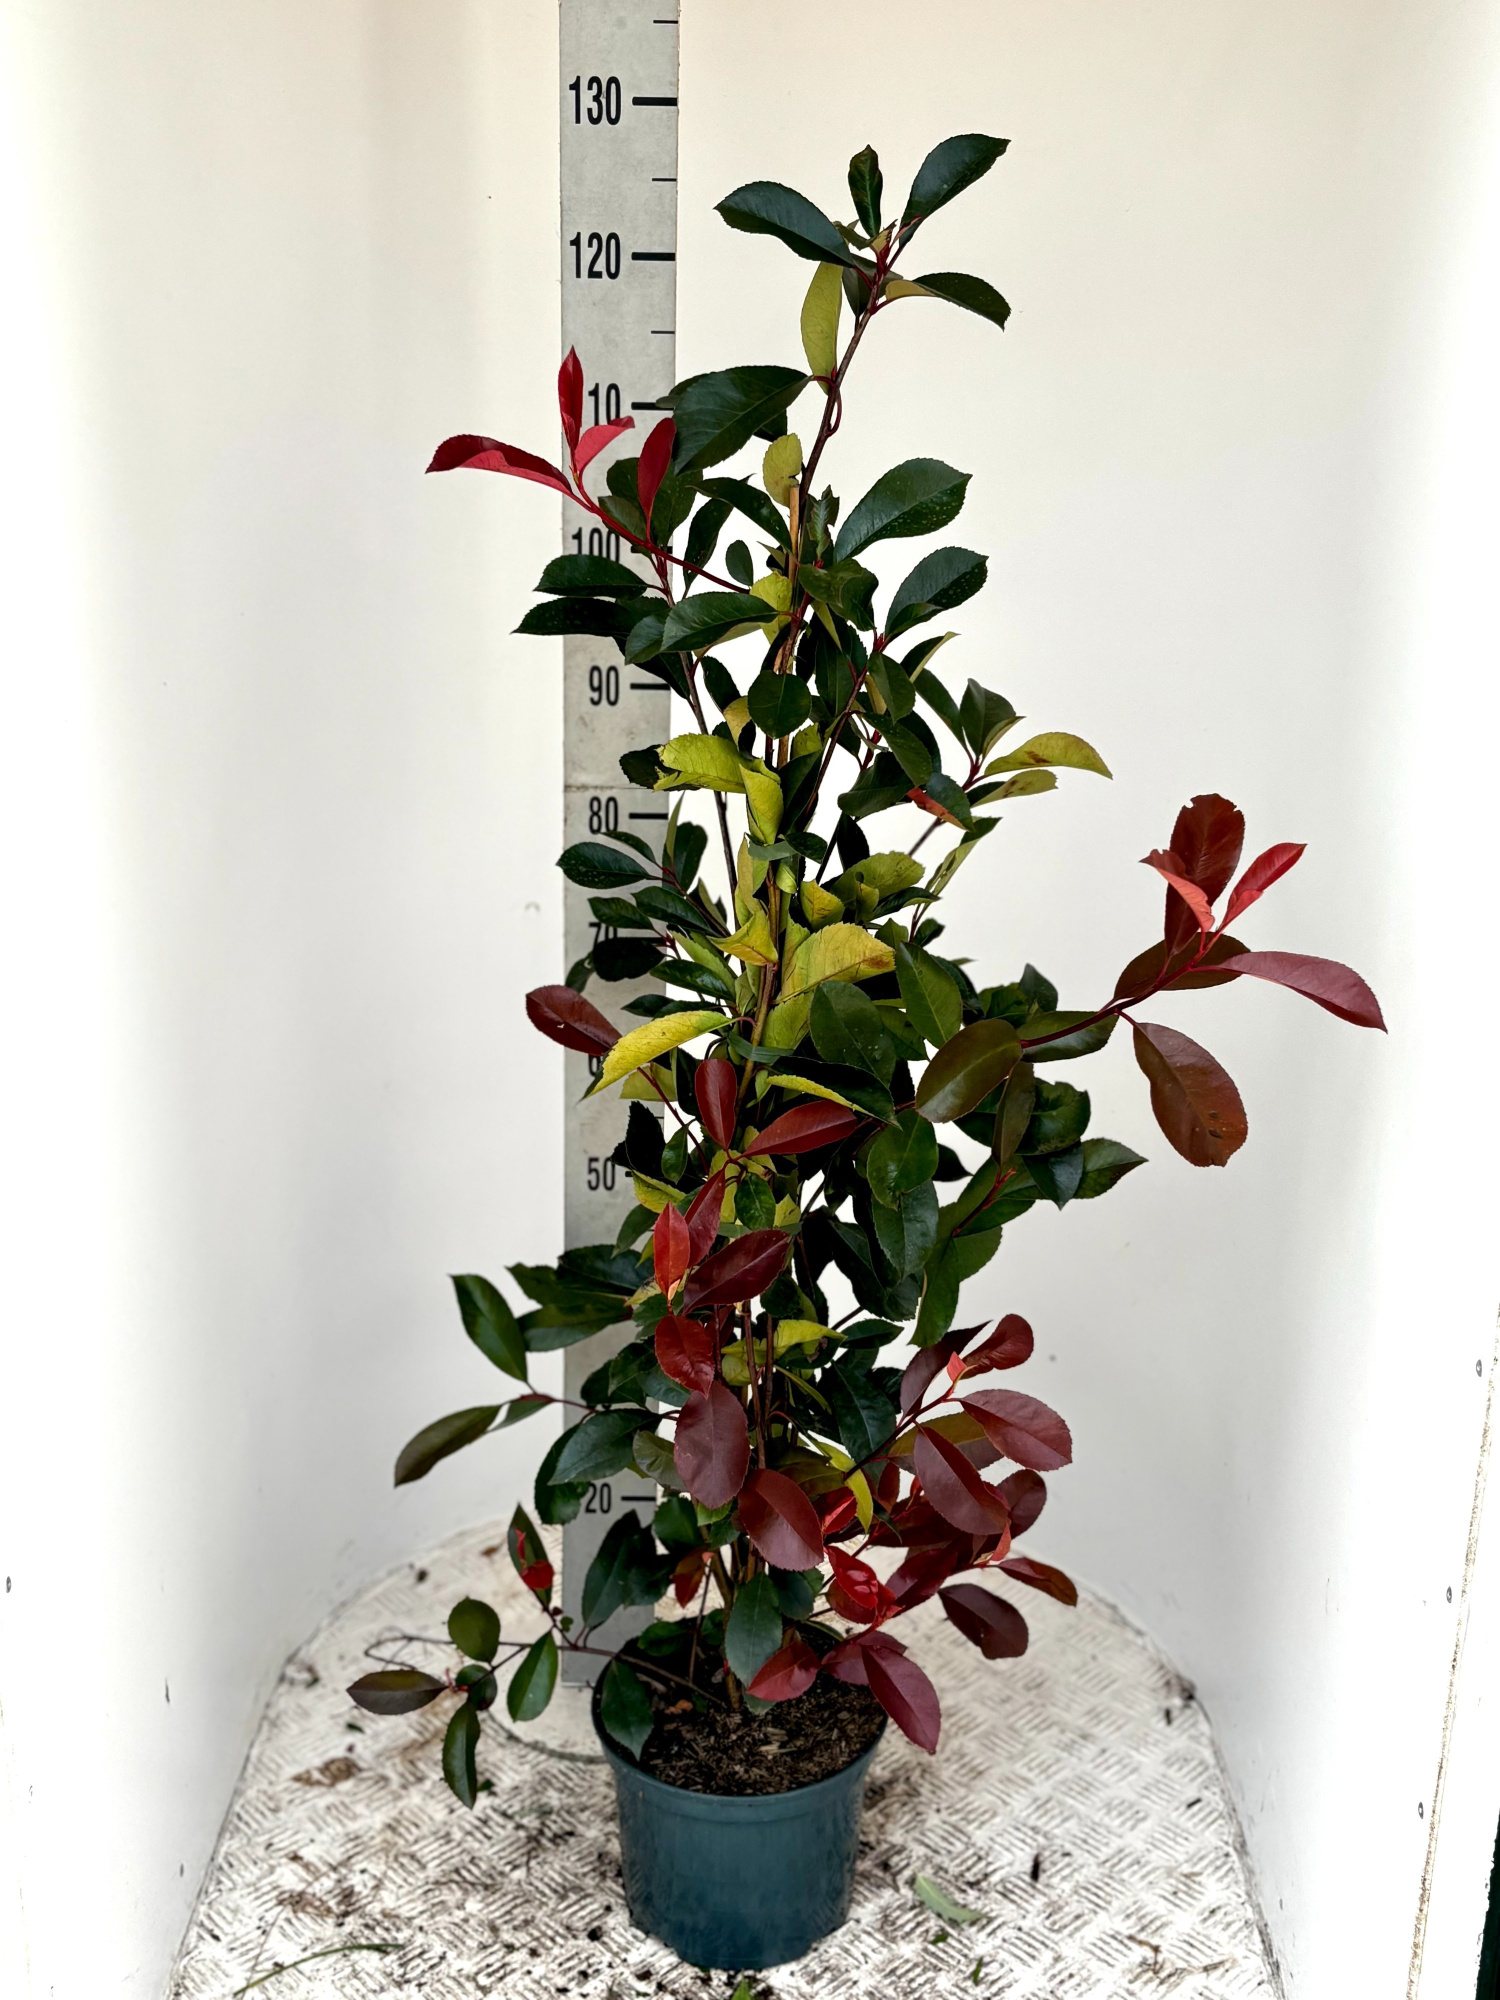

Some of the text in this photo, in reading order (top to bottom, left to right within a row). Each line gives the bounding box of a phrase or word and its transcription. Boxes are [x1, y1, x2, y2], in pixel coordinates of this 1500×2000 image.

[569, 75, 621, 125] 130
[569, 231, 621, 279] 120
[588, 382, 621, 426] 10
[589, 665, 619, 706] 90
[589, 796, 618, 835] 80
[587, 1157, 616, 1191] 50
[585, 1482, 611, 1514] 20
